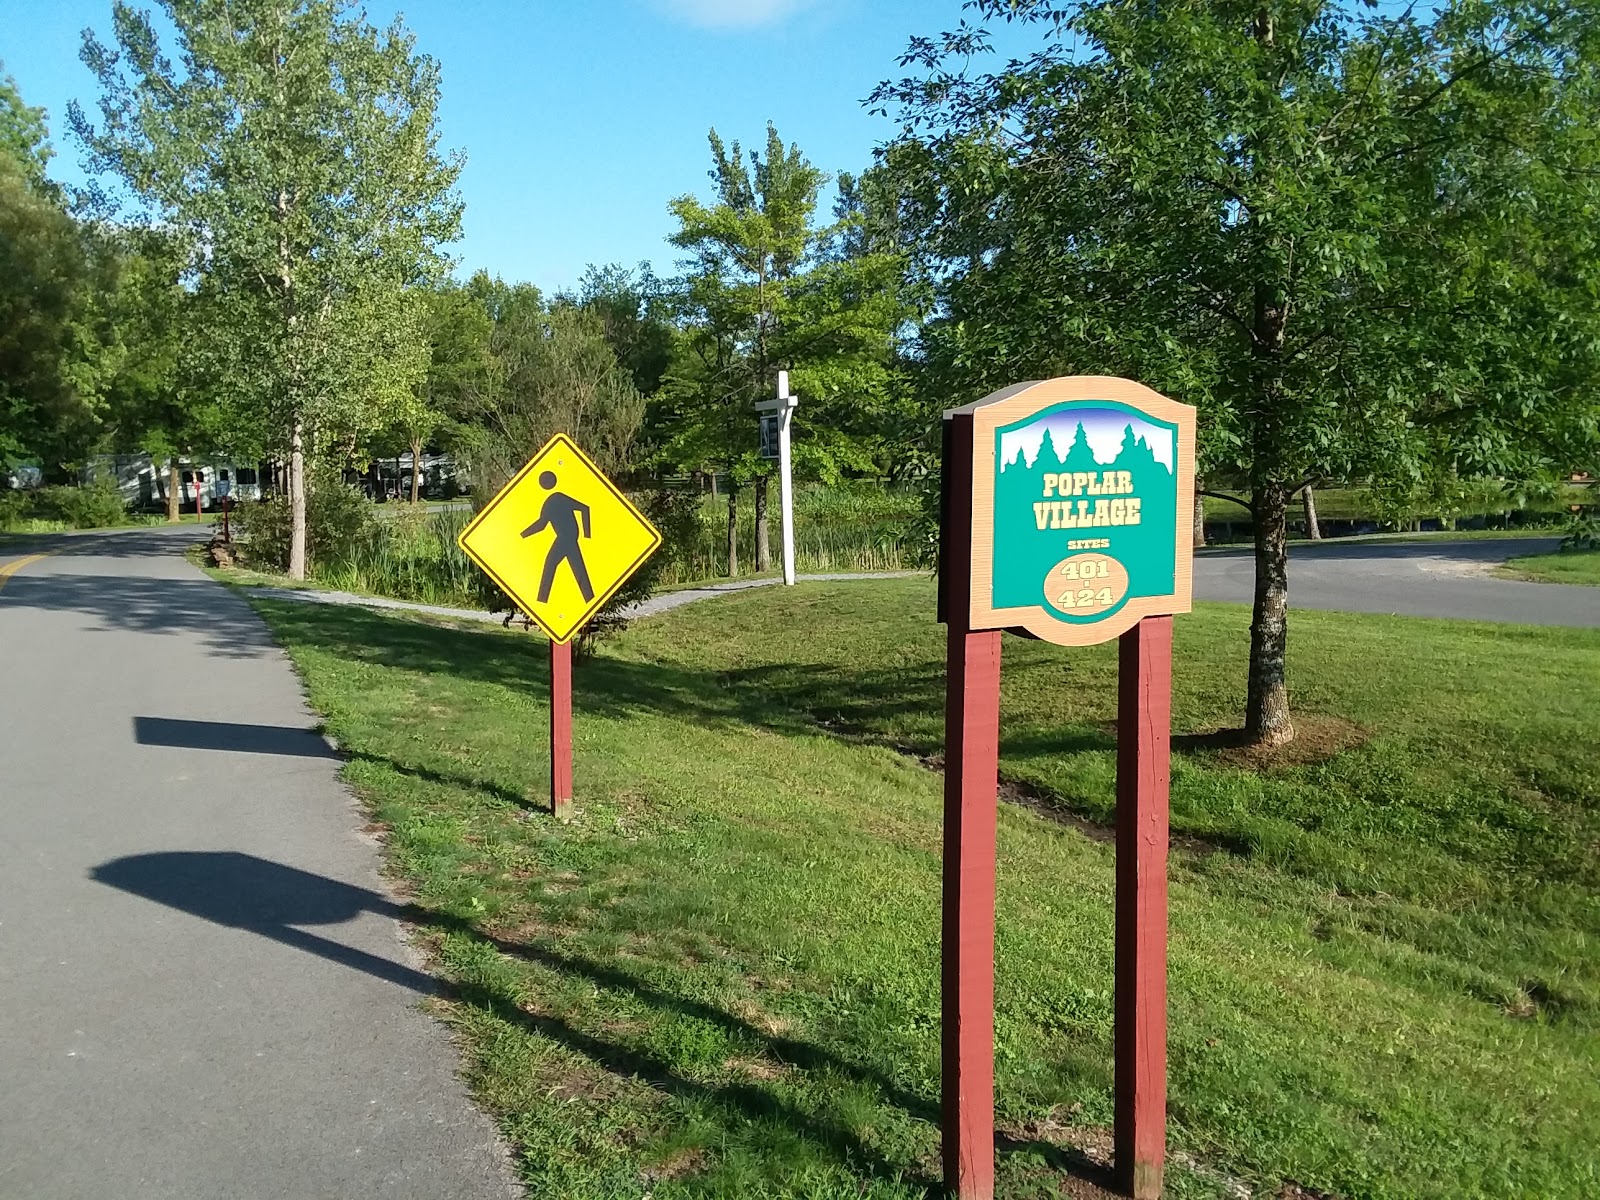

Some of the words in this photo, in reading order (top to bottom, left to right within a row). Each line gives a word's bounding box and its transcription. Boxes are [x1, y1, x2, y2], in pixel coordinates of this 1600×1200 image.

[1043, 470, 1133, 497] POPLAR
[1033, 498, 1141, 530] VILLAGE
[1067, 538, 1110, 550] SITES
[1061, 560, 1109, 580] 401
[1057, 587, 1113, 608] 424
